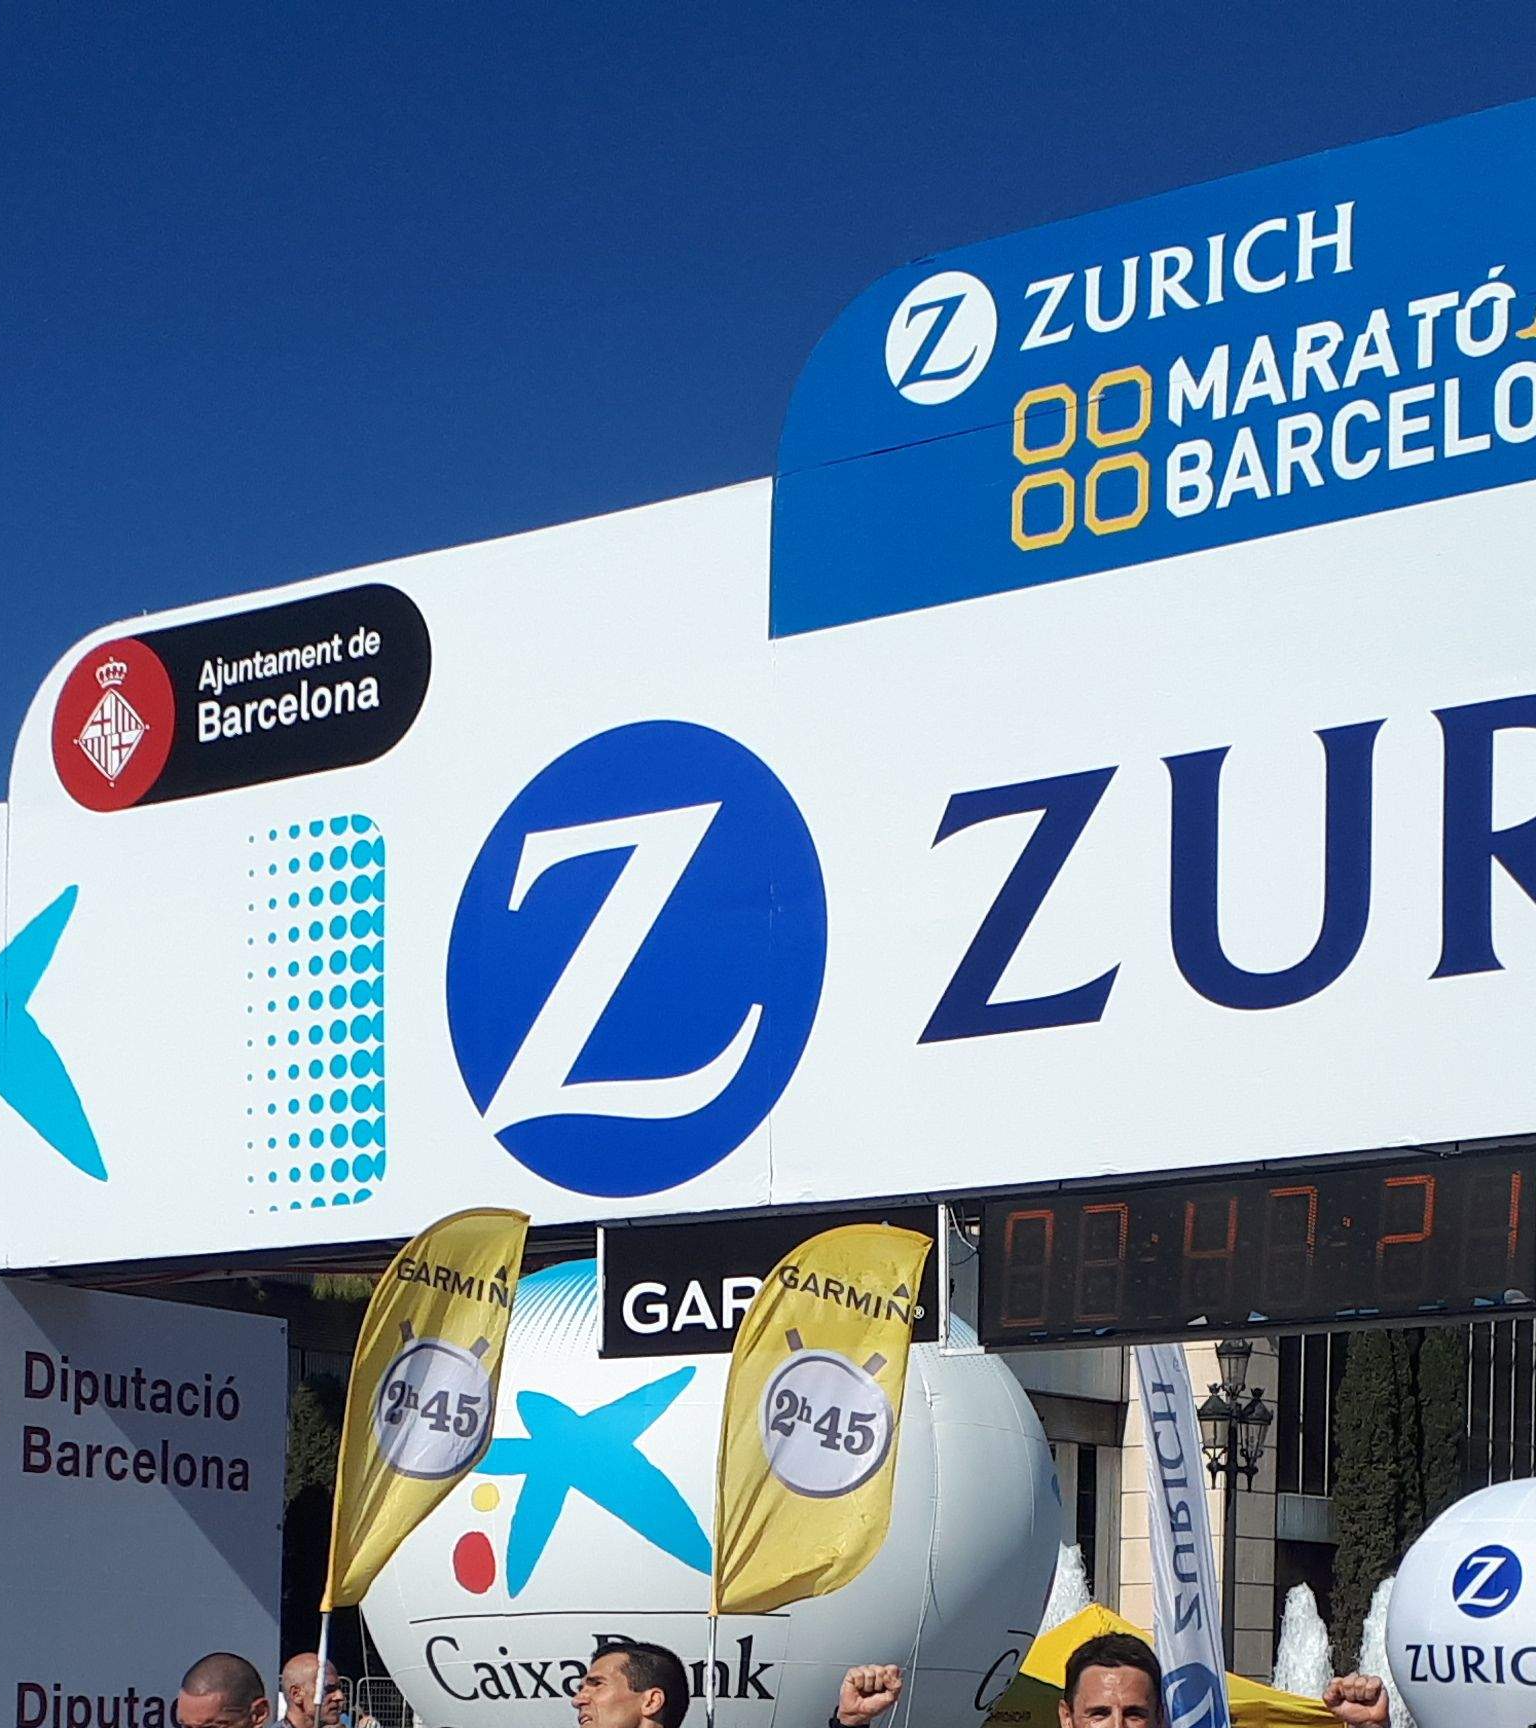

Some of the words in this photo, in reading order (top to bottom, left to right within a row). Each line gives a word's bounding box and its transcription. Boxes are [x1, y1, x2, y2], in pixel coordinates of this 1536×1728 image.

[1020, 200, 1356, 352] ZURICH
[1167, 265, 1518, 428] MARATÓ
[198, 640, 342, 692] Ajuntament
[348, 626, 382, 659] de
[197, 673, 381, 745] Barcelona
[396, 1256, 510, 1308] GARMIN
[779, 1265, 911, 1326] GARMIN
[24, 1351, 241, 1422] Diputació
[769, 1388, 878, 1456] 2h45
[22, 1425, 252, 1493] Barcelona
[425, 1633, 775, 1702] Caixank
